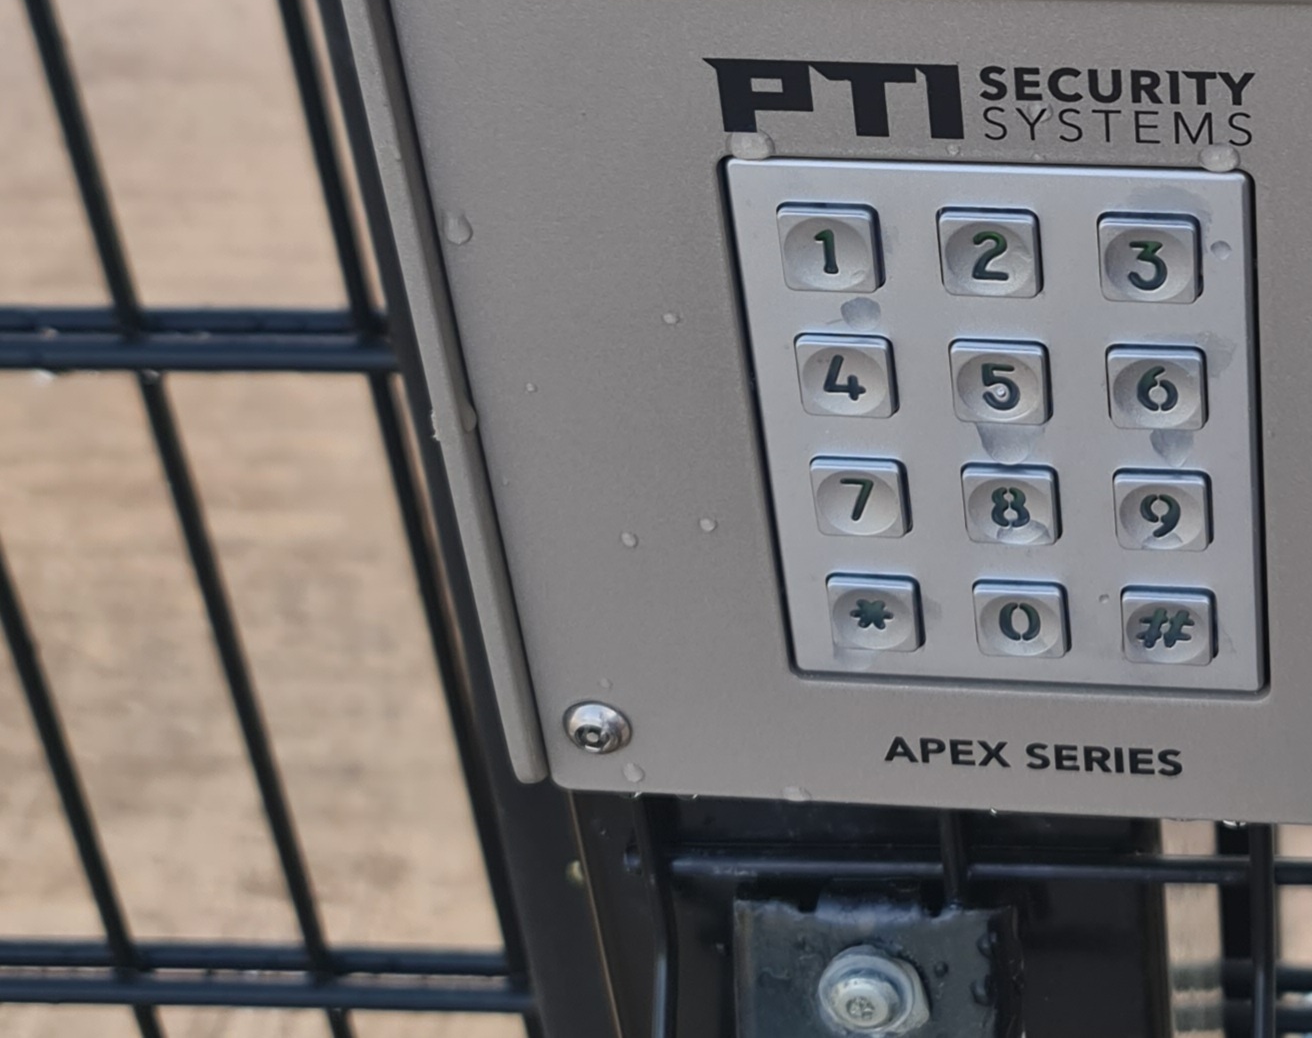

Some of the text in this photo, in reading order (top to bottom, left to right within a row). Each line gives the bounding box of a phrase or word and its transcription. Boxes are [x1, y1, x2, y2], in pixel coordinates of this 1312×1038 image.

[702, 58, 965, 140] PTI
[979, 66, 1256, 106] SECURITY
[982, 106, 1254, 147] SYSTEMS
[814, 228, 839, 274] 1
[972, 231, 1010, 281] 2
[1127, 240, 1168, 291] 3
[822, 354, 866, 400] 4
[981, 363, 1020, 411] 5
[1137, 365, 1179, 412] 6
[839, 478, 873, 521] 7
[990, 486, 1031, 528] 8
[1140, 494, 1181, 538] 9
[998, 602, 1041, 641] 0
[884, 736, 1183, 777] APEX SERIES
